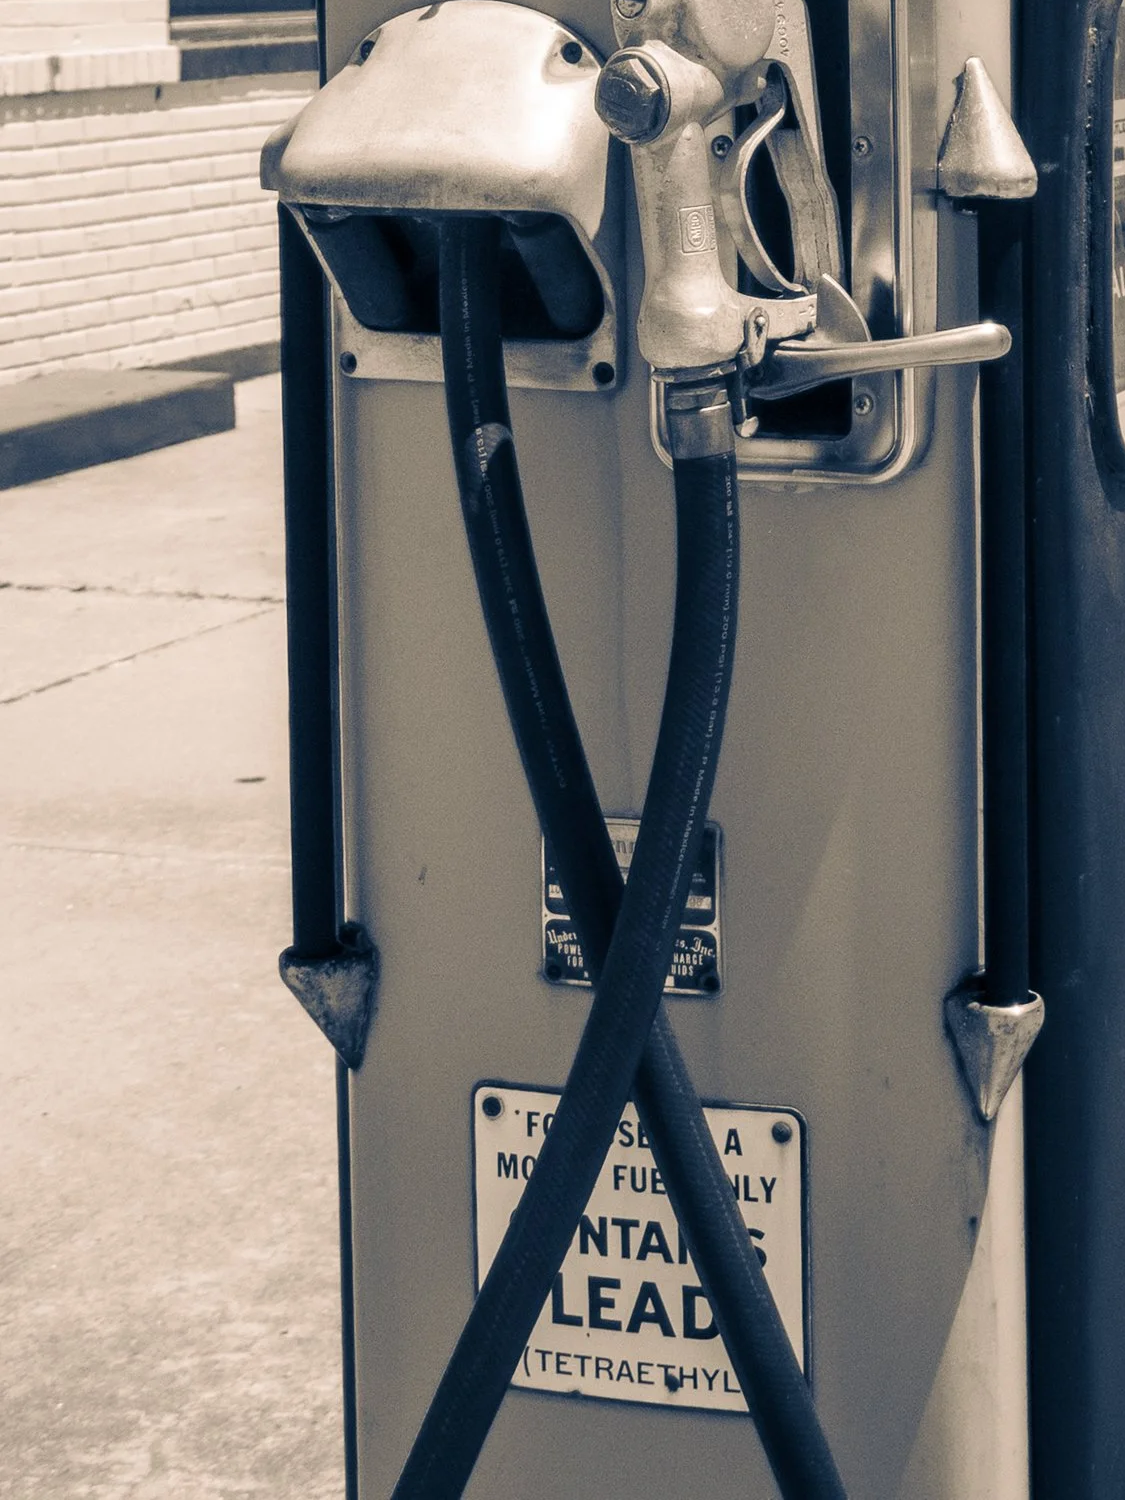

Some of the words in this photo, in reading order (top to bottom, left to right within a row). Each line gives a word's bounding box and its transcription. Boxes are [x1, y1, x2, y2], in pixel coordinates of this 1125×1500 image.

[461, 277, 471, 319] Mexico
[693, 768, 706, 803] Made
[689, 805, 697, 817] in
[678, 819, 694, 862] Mexico
[557, 943, 582, 956] POWE
[724, 1128, 743, 1156] A
[612, 1165, 667, 1195] FUE
[551, 1271, 722, 1341] LEAD
